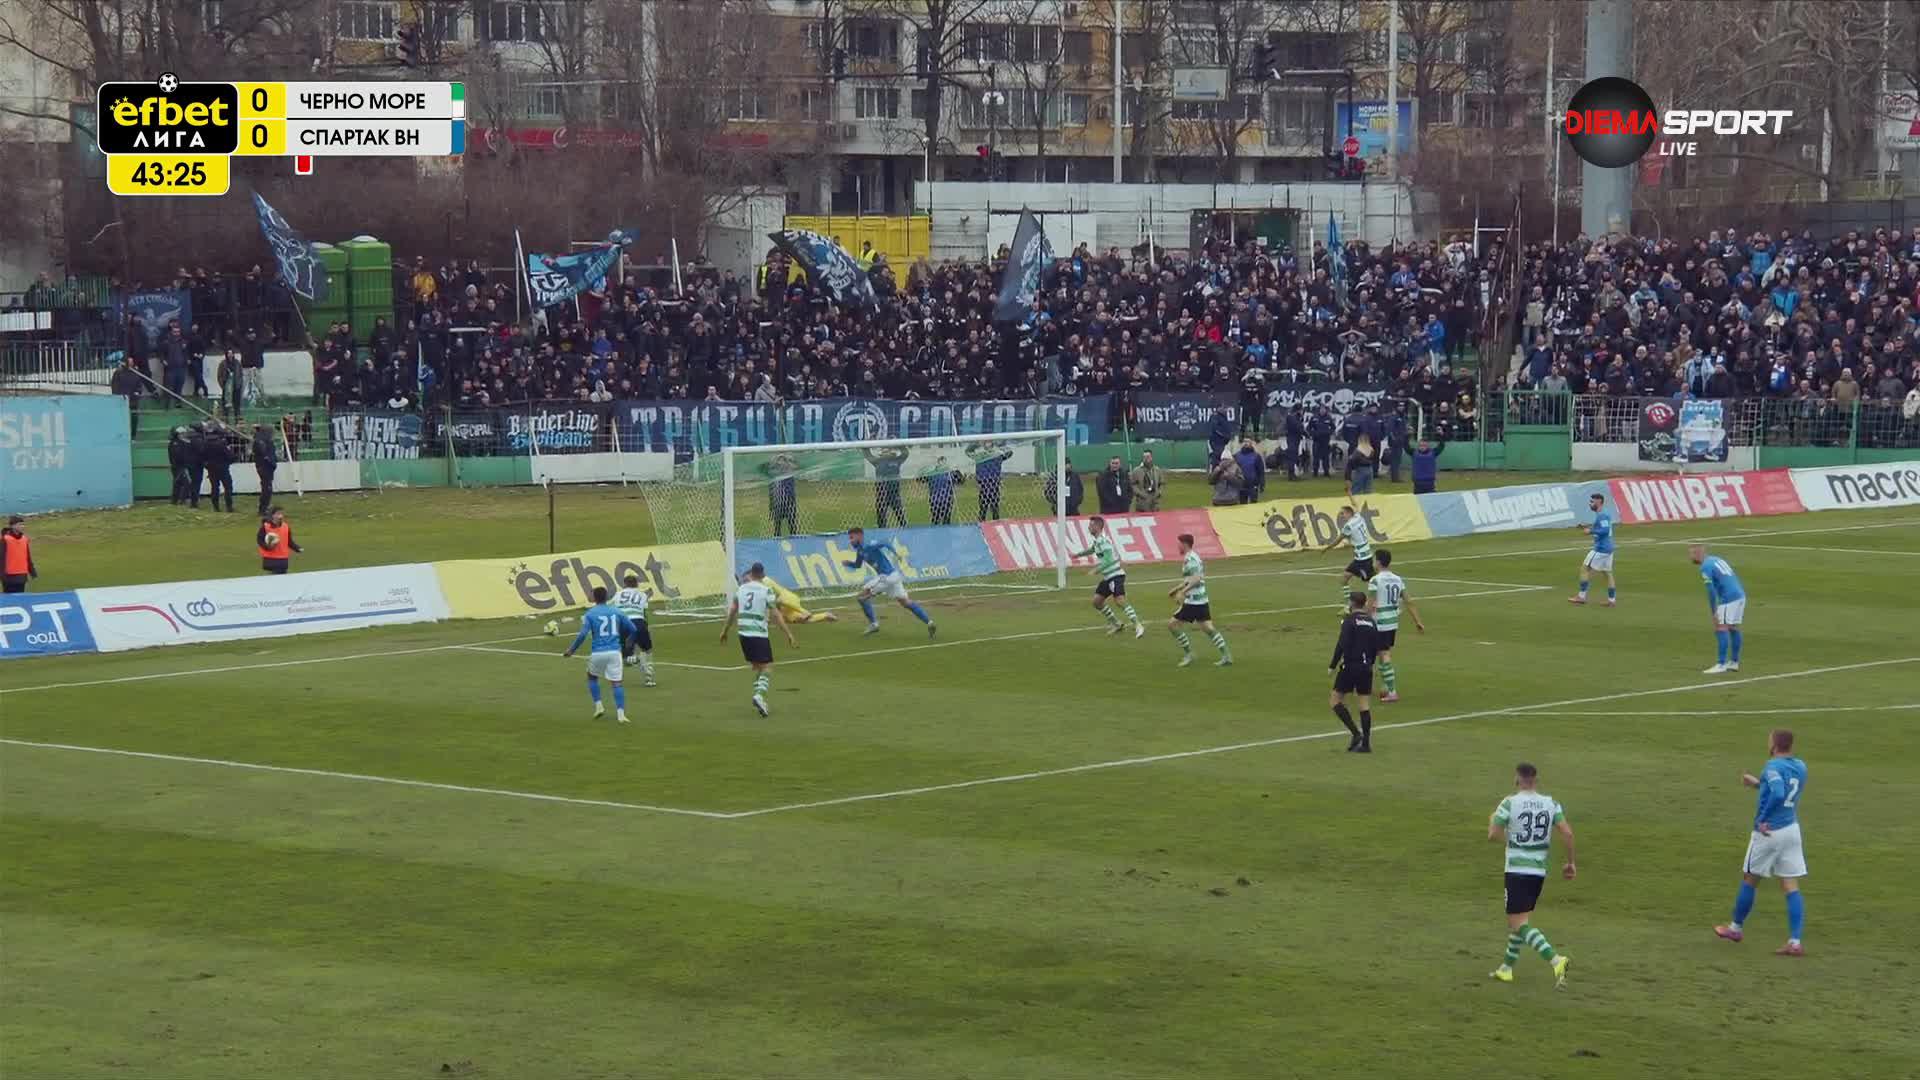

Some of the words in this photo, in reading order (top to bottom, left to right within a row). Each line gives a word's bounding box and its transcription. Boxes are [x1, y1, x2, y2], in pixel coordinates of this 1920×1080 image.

[1136, 407, 1169, 422] MOST
[331, 415, 360, 440] THE
[1619, 475, 1752, 522] WINBET
[996, 516, 1164, 569] WINET
[743, 592, 754, 610] 3
[1385, 583, 1400, 605] 10
[599, 613, 619, 637] 21
[1783, 777, 1800, 808] 2
[1516, 810, 1551, 843] 39
